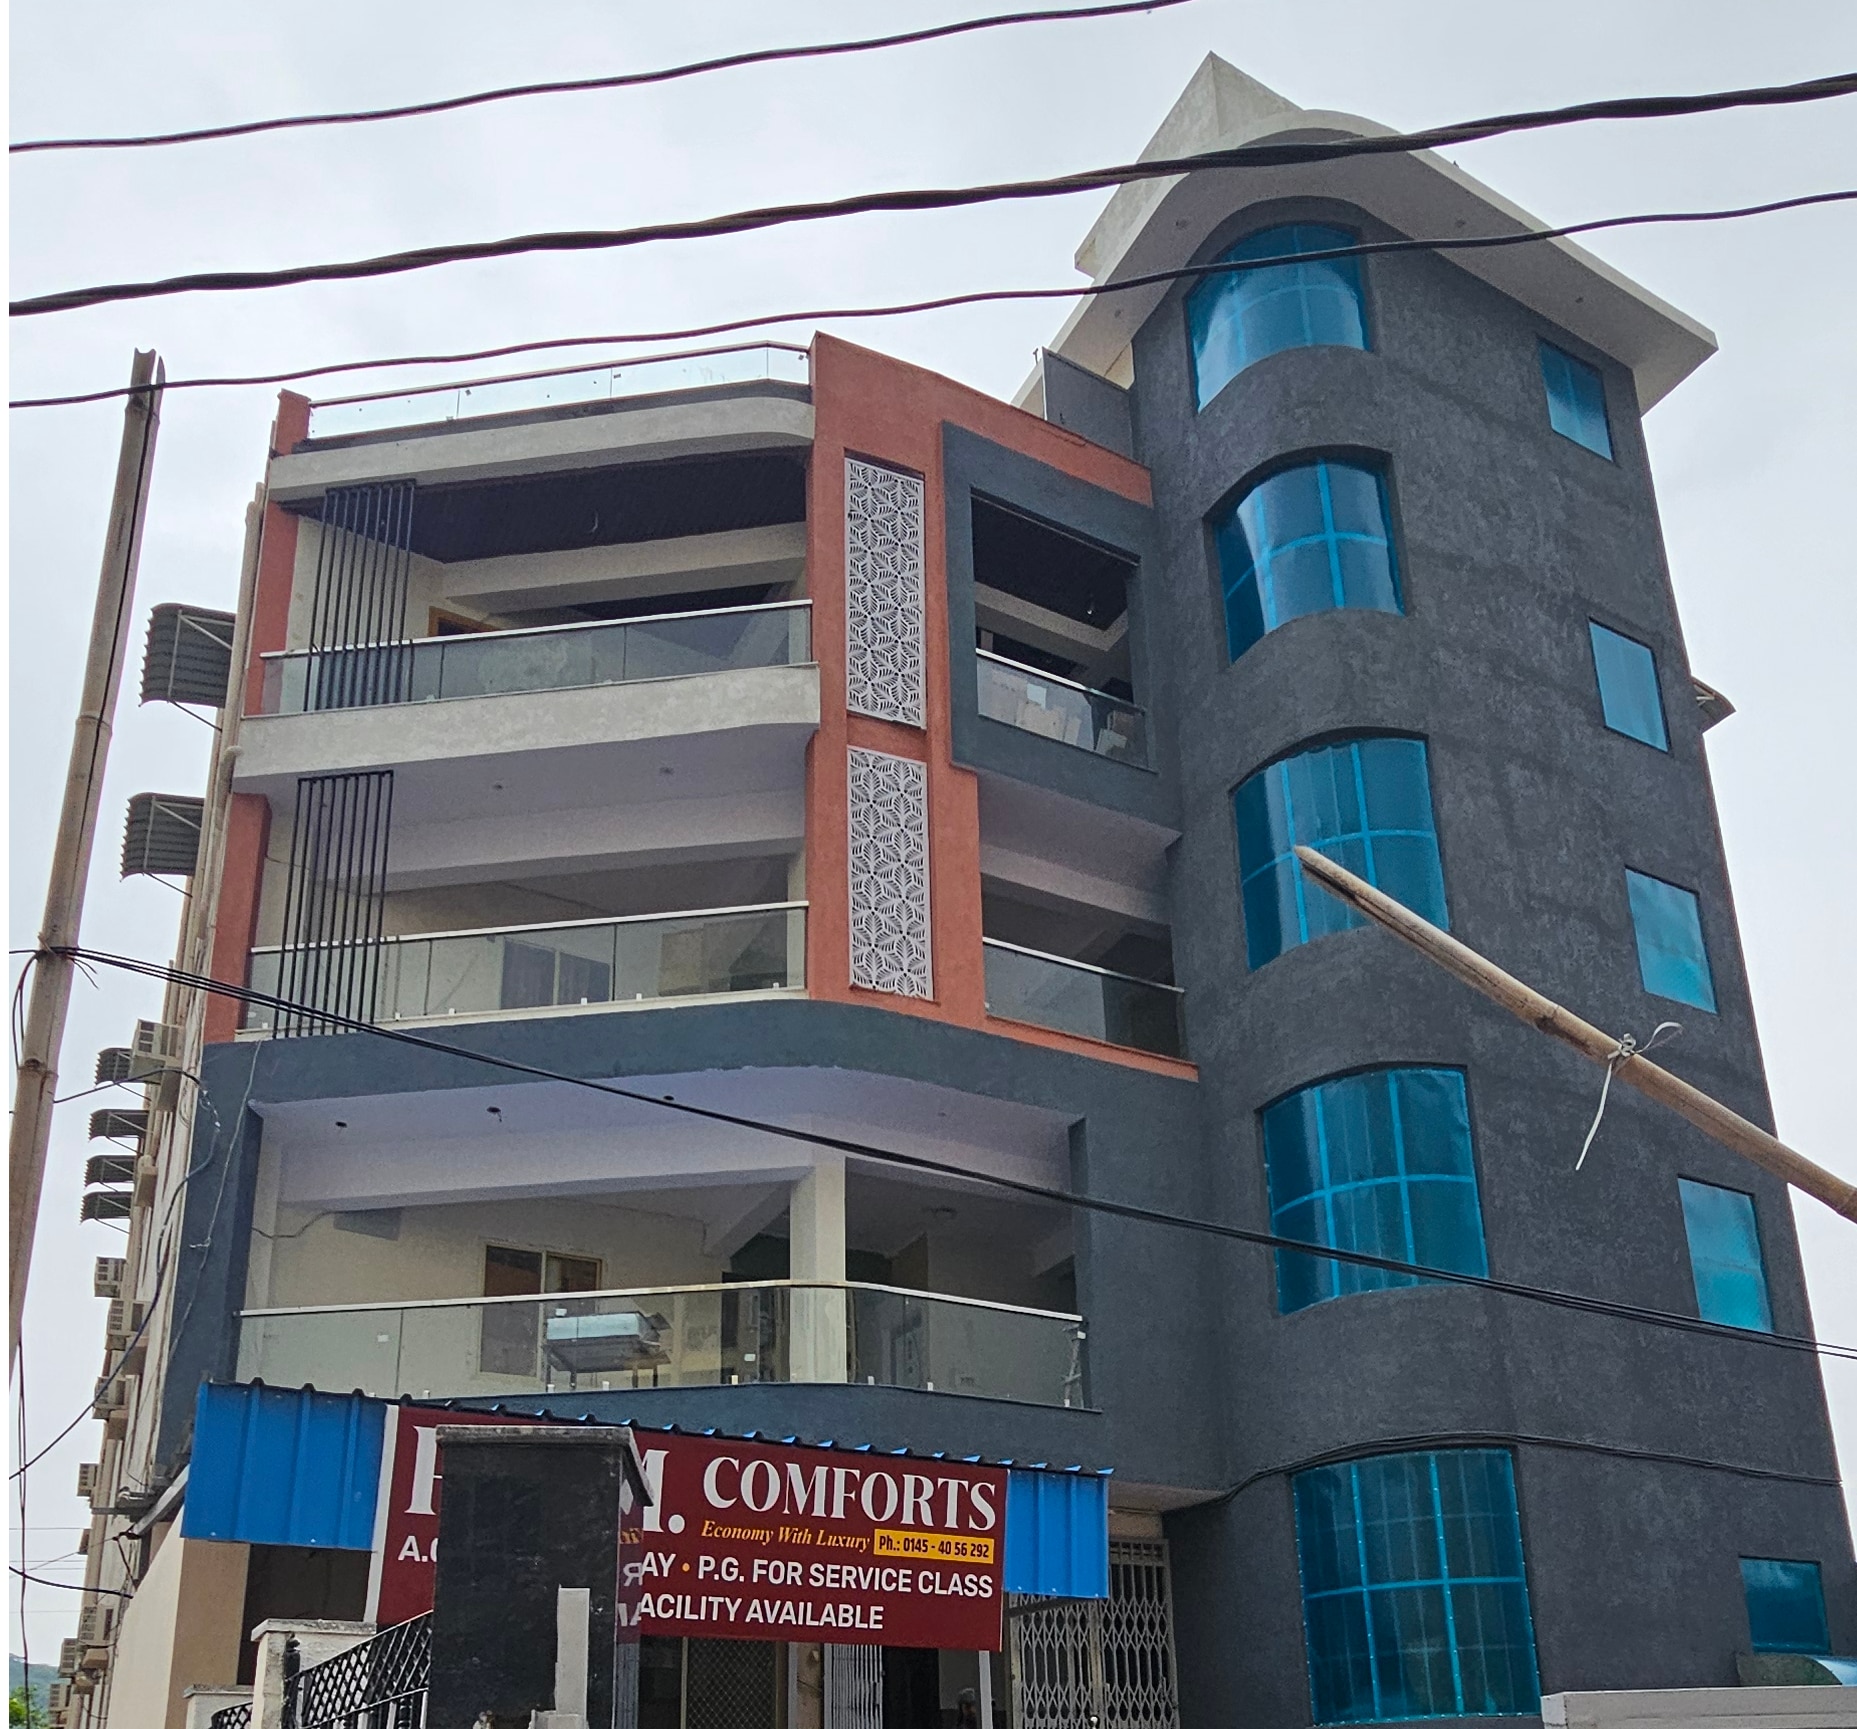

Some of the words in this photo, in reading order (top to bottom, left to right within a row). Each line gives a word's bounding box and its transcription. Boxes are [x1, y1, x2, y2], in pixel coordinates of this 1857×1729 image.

[703, 1456, 996, 1531] COMFORTS
[701, 1520, 774, 1545] Economy
[778, 1526, 812, 1545] With
[816, 1529, 870, 1553] Luxury
[879, 1535, 900, 1552] Ph.:
[903, 1537, 929, 1553] 0145
[938, 1540, 952, 1556] 40
[954, 1541, 968, 1557] 56
[970, 1543, 990, 1559] 292
[698, 1555, 745, 1582] P.G.
[752, 1558, 803, 1586] FOR
[808, 1562, 913, 1593] SERVICE
[917, 1570, 993, 1599] CLASS
[745, 1598, 885, 1630] AVAILABLE
